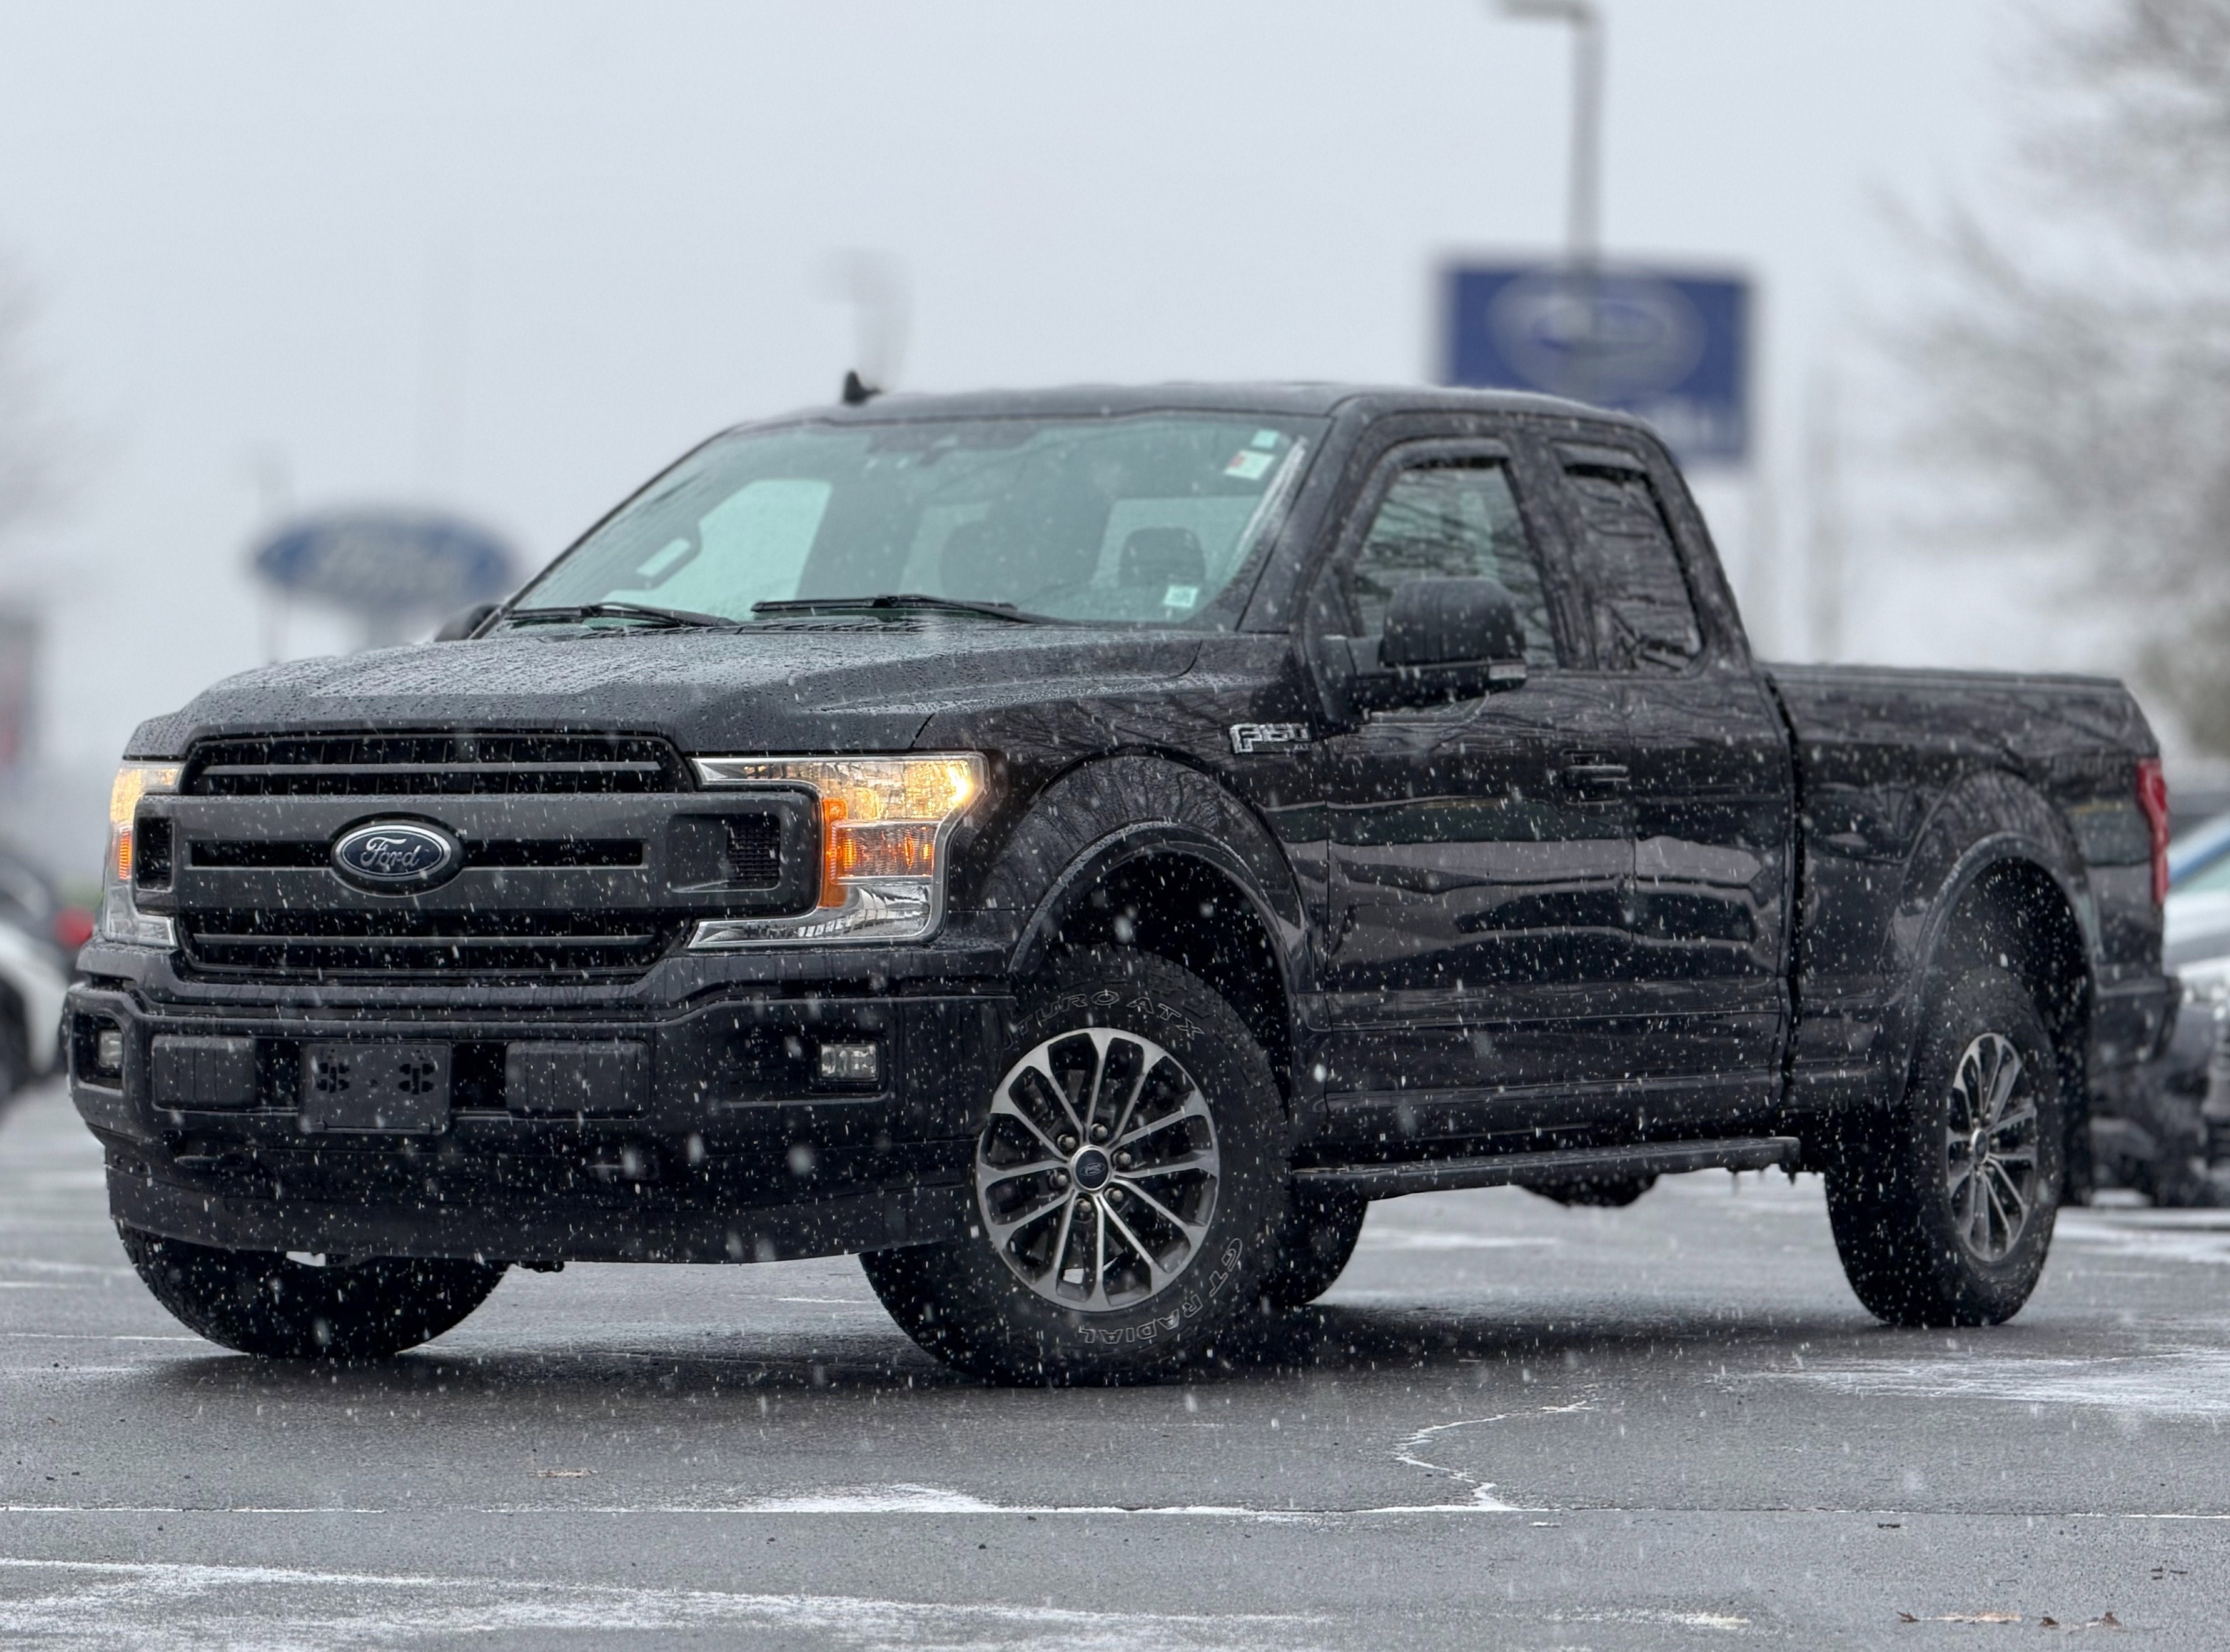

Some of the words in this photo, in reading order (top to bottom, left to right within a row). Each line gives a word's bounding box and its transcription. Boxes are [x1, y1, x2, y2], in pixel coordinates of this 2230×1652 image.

[361, 837, 422, 868] Ford
[1126, 996, 1204, 1040] ATX
[1207, 1238, 1243, 1298] GT
[1077, 1294, 1203, 1344] RADIAL
